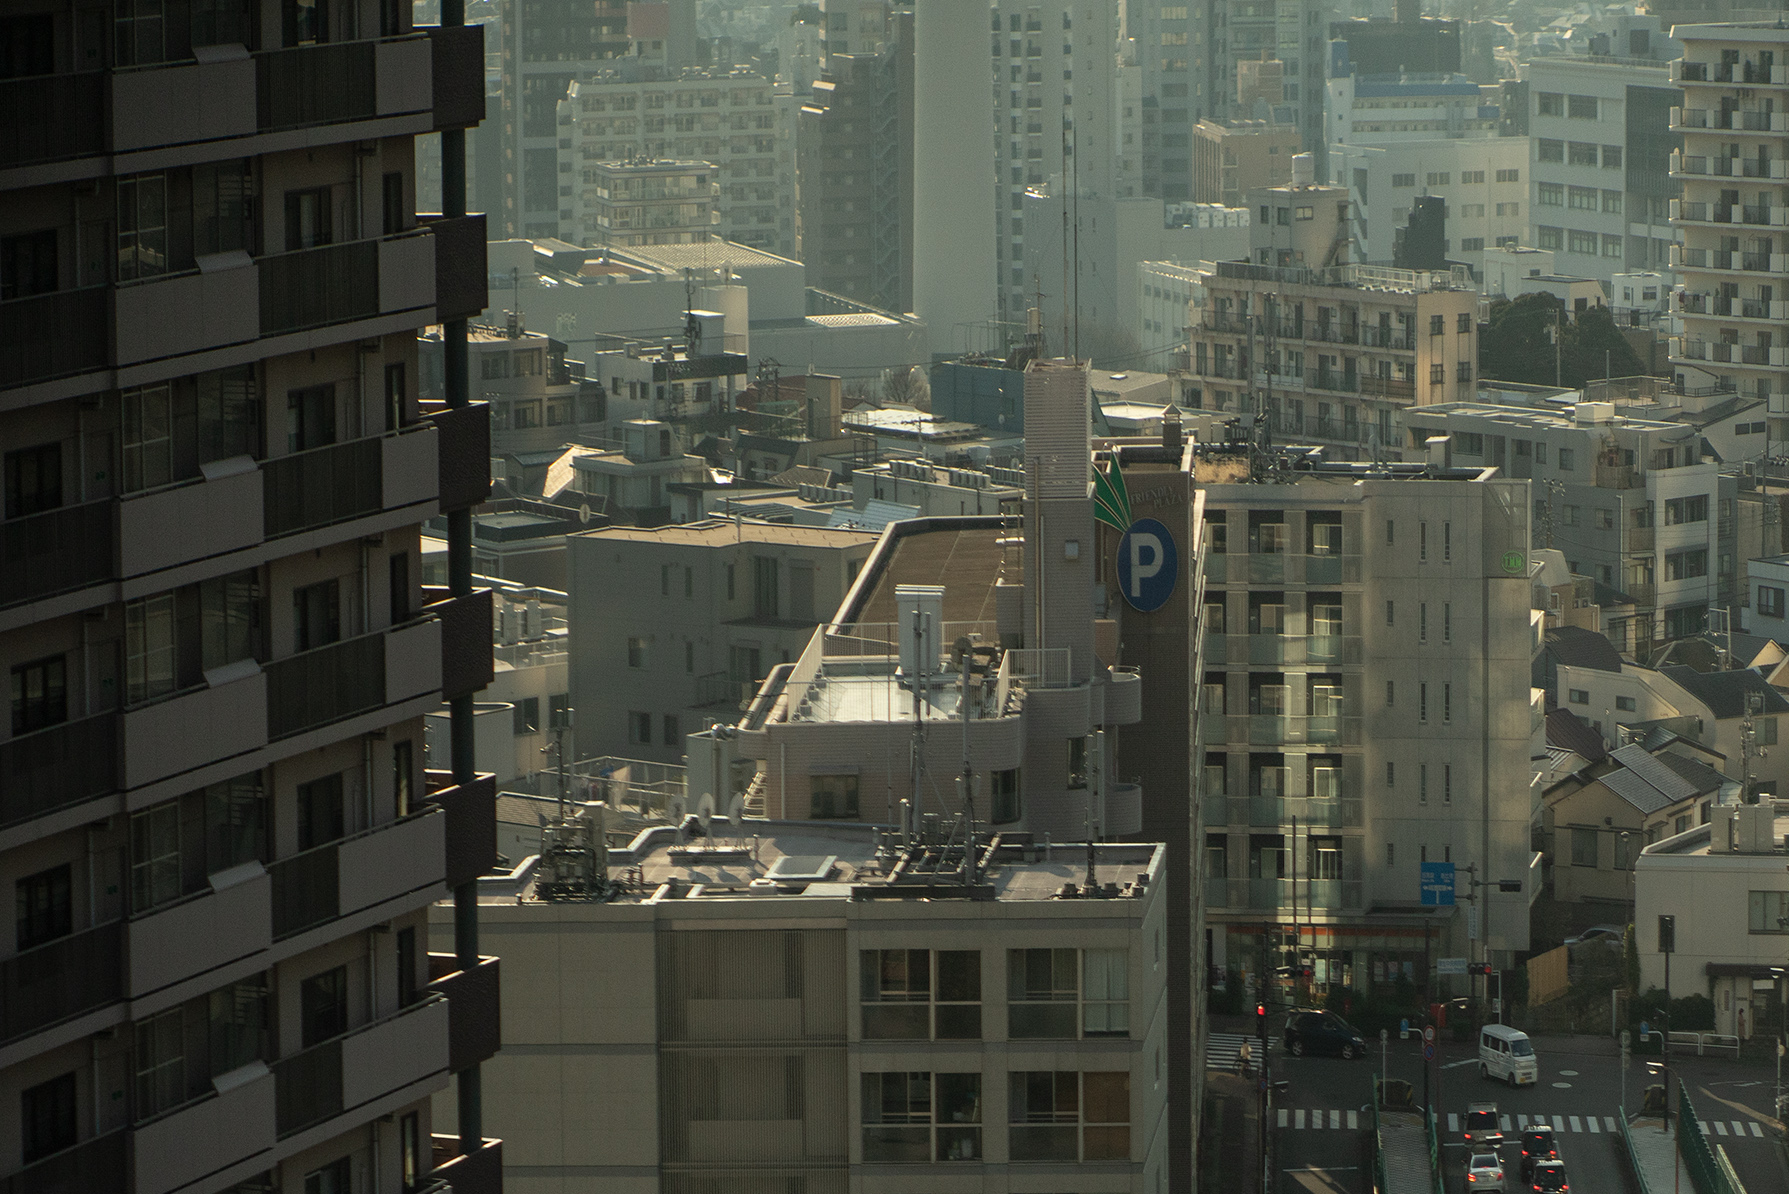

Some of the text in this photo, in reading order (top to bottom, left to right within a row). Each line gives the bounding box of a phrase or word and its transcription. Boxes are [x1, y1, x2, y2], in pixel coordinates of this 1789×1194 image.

[1130, 485, 1174, 505] FRIENDLY
[1153, 493, 1182, 509] PLAZA
[1130, 532, 1164, 598] P
